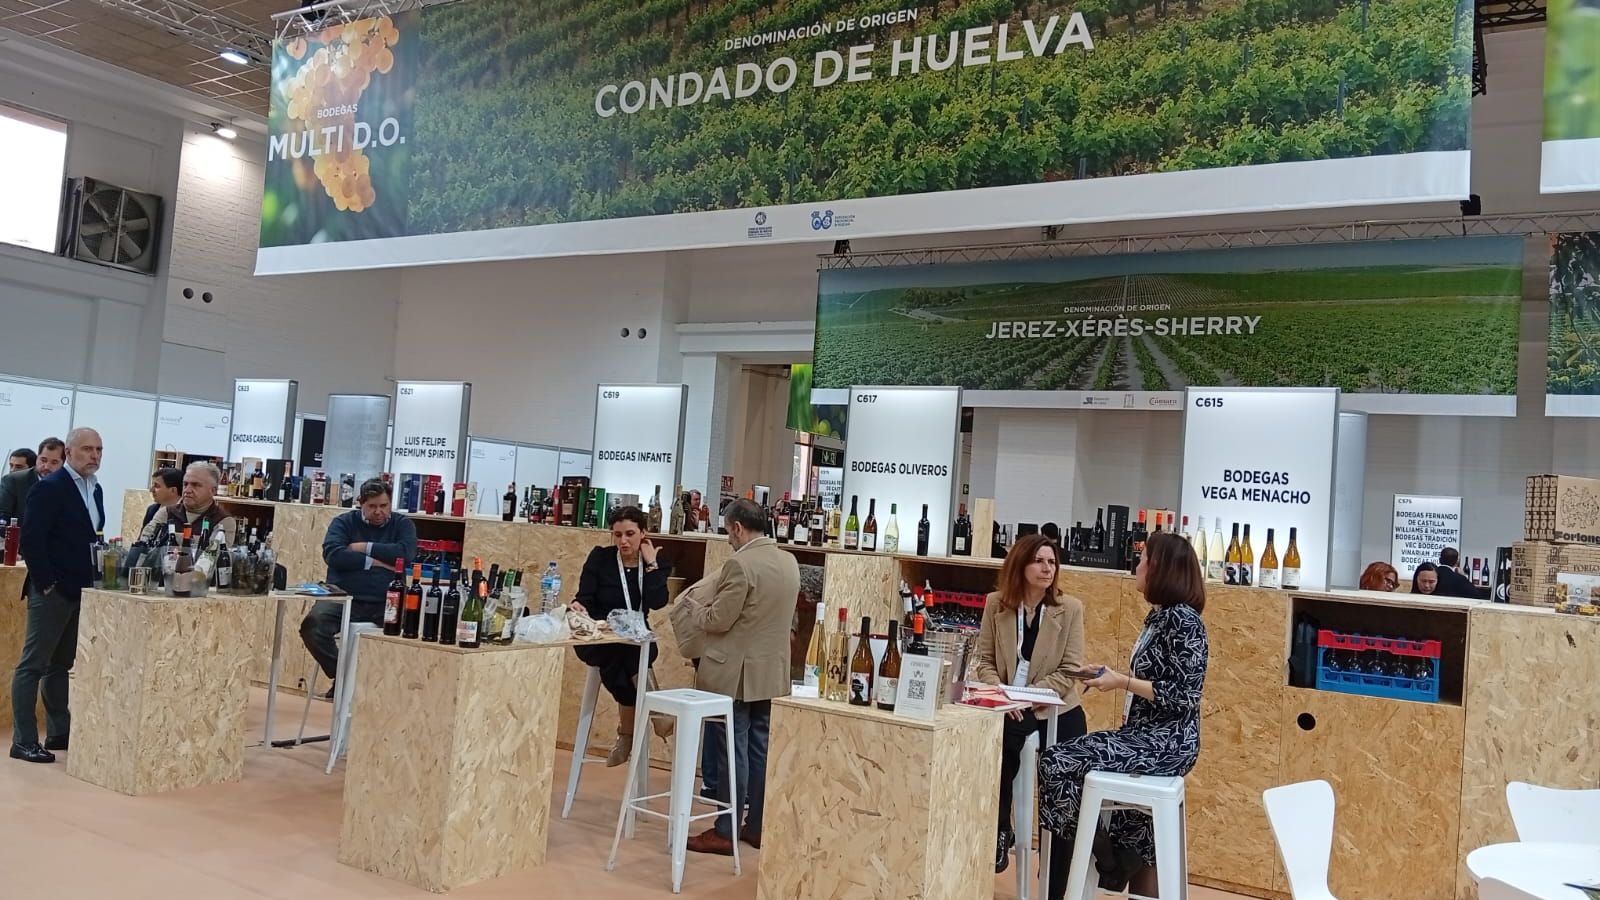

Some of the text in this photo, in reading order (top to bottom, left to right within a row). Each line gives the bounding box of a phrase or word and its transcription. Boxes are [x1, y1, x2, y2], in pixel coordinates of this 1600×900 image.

[725, 8, 918, 50] DENOMINACIÓN DE ORIGEN
[595, 12, 1095, 118] CONDADO DE HUELVA
[317, 103, 359, 118] BODEGAS
[268, 117, 406, 161] MULTI D.O.
[1063, 303, 1171, 314] DENOMINACIÓN DE ORIGEN
[985, 313, 1262, 339] JEREZ-XÉRÈS-SHERRY
[603, 391, 620, 399] C619
[857, 394, 877, 403] C617
[1195, 397, 1223, 408] C615
[232, 433, 283, 445] CHOZAS CARRASCAL
[404, 436, 446, 447] LUIS FELIPE
[395, 447, 456, 460] PREMIUM SPIRITS
[598, 450, 672, 463] BODEGAS INFANTE
[851, 461, 948, 477] BODEGAS OLIVEROS
[1223, 469, 1289, 485] BODEGAS
[1201, 485, 1311, 505] VEGA MENACHO
[1425, 512, 1458, 520] FERNANDO
[1425, 535, 1457, 543] TRADICIÓN
